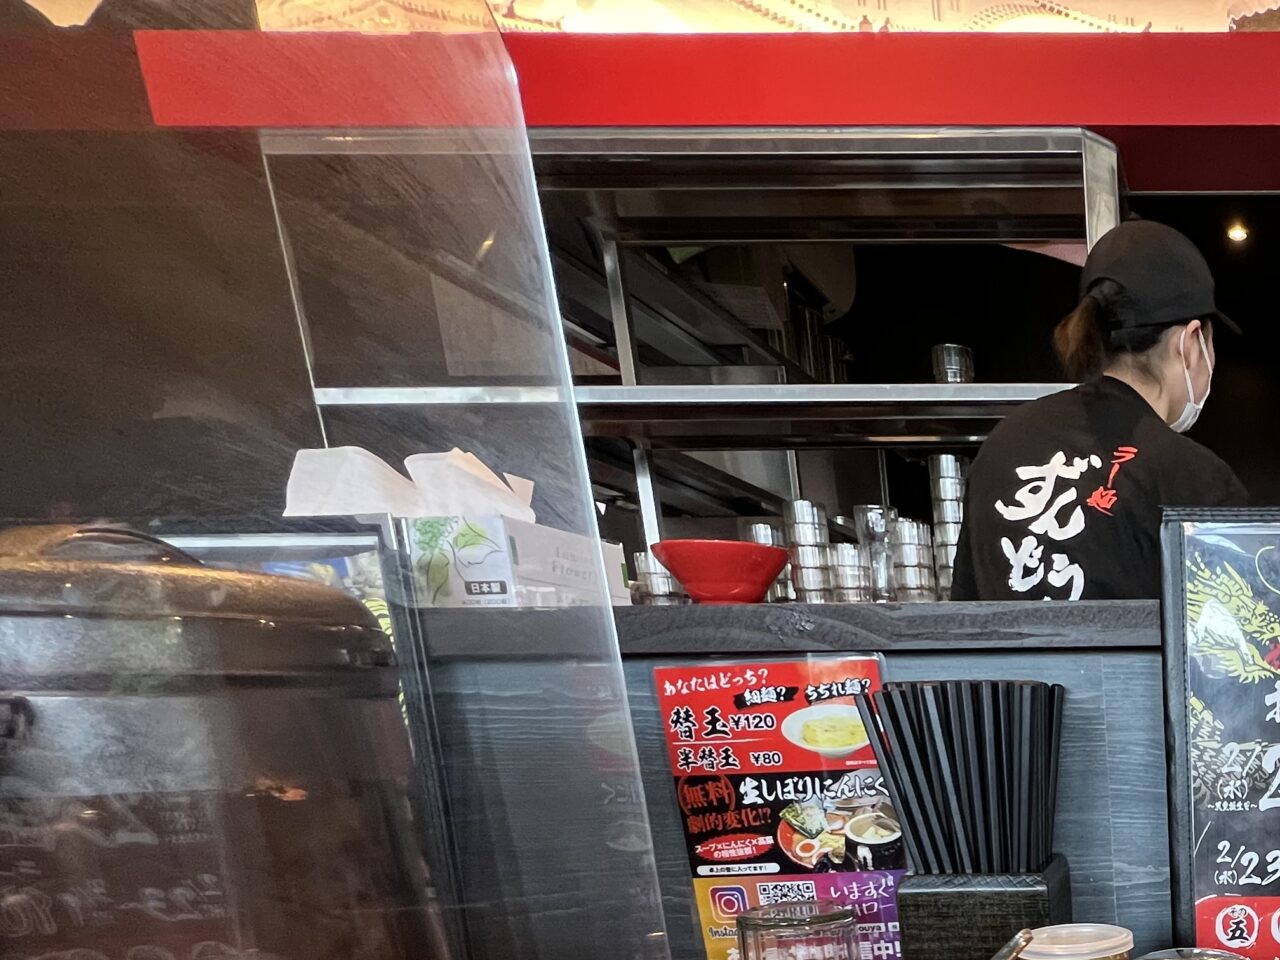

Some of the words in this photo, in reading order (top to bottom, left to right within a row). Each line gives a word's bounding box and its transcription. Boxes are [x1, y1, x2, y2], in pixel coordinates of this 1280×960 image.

[663, 668, 769, 696] あなたはどっち?
[744, 686, 786, 705] 細麺?
[669, 705, 732, 741] 替玉
[730, 714, 777, 730] ¥120
[677, 747, 740, 772] 半替玉
[750, 752, 783, 767] ¥80
[682, 779, 732, 809] 無料
[739, 775, 890, 805] 生しぼりにんにく
